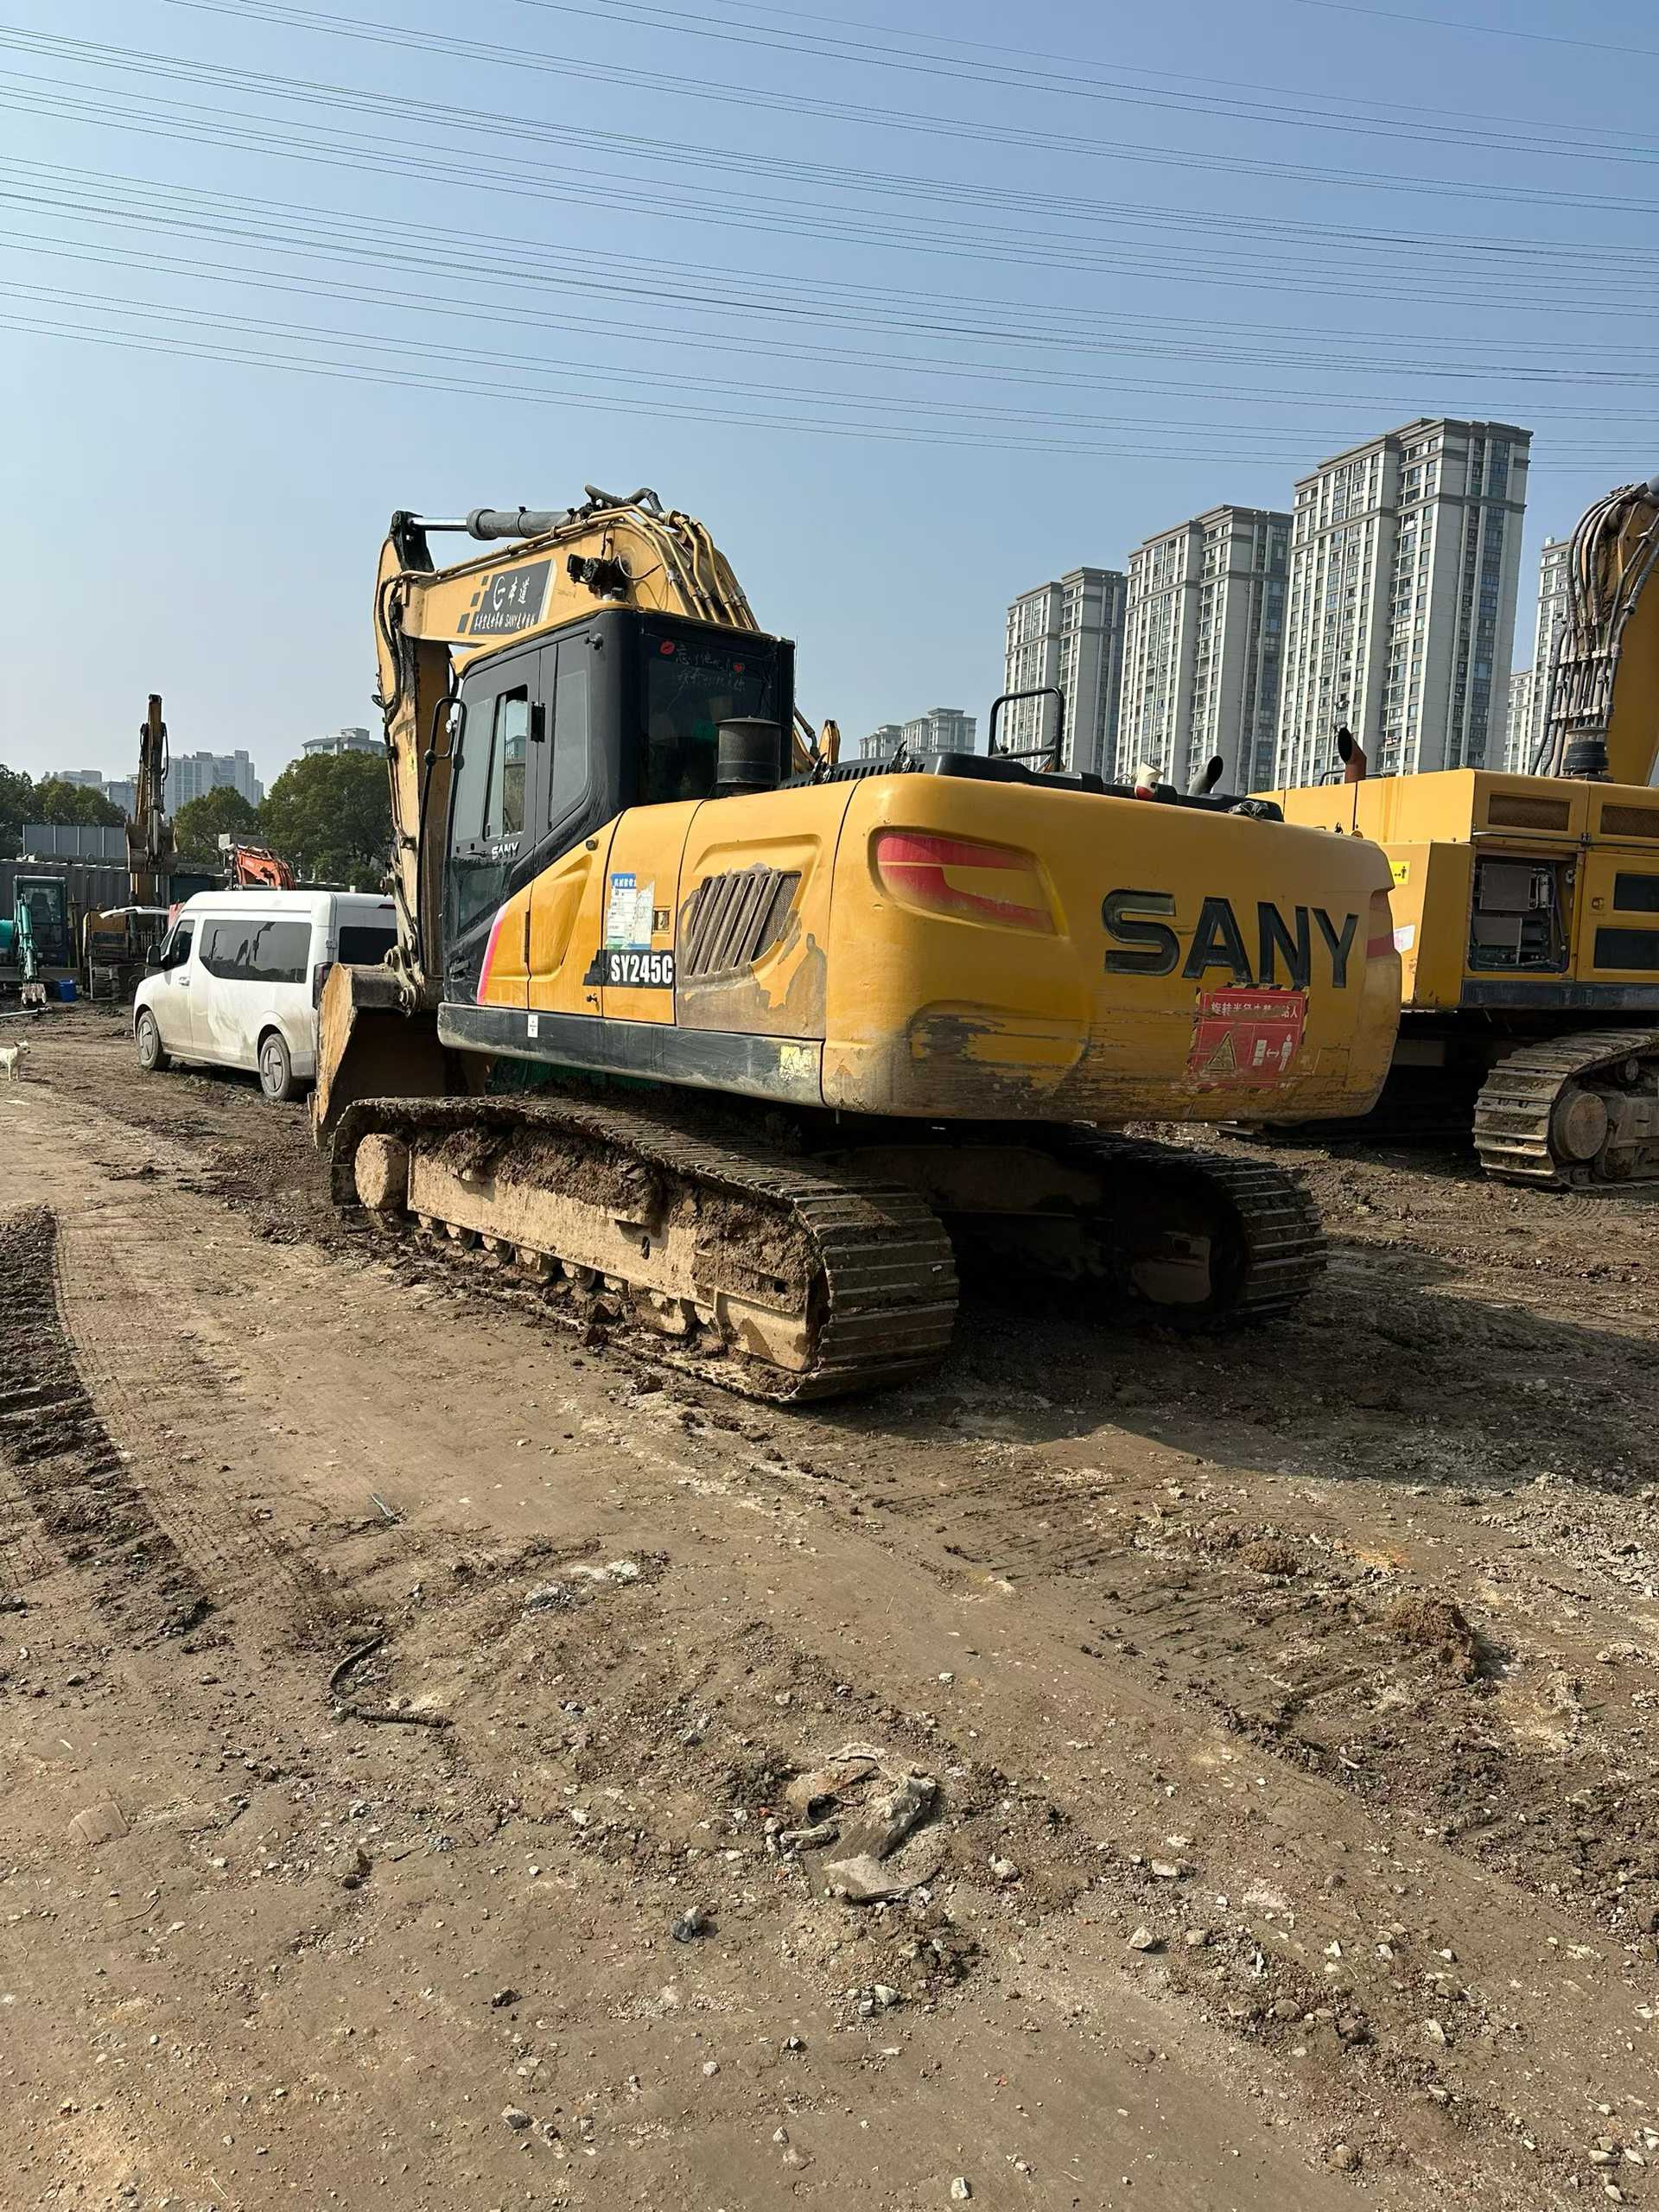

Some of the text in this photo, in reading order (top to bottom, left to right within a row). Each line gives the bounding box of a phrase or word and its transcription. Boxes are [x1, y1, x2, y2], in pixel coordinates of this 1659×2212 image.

[491, 842, 519, 860] SANY
[1101, 888, 1359, 990] SANY
[610, 954, 674, 984] SY245C
[1211, 1001, 1299, 1019] 旋转半径站人
